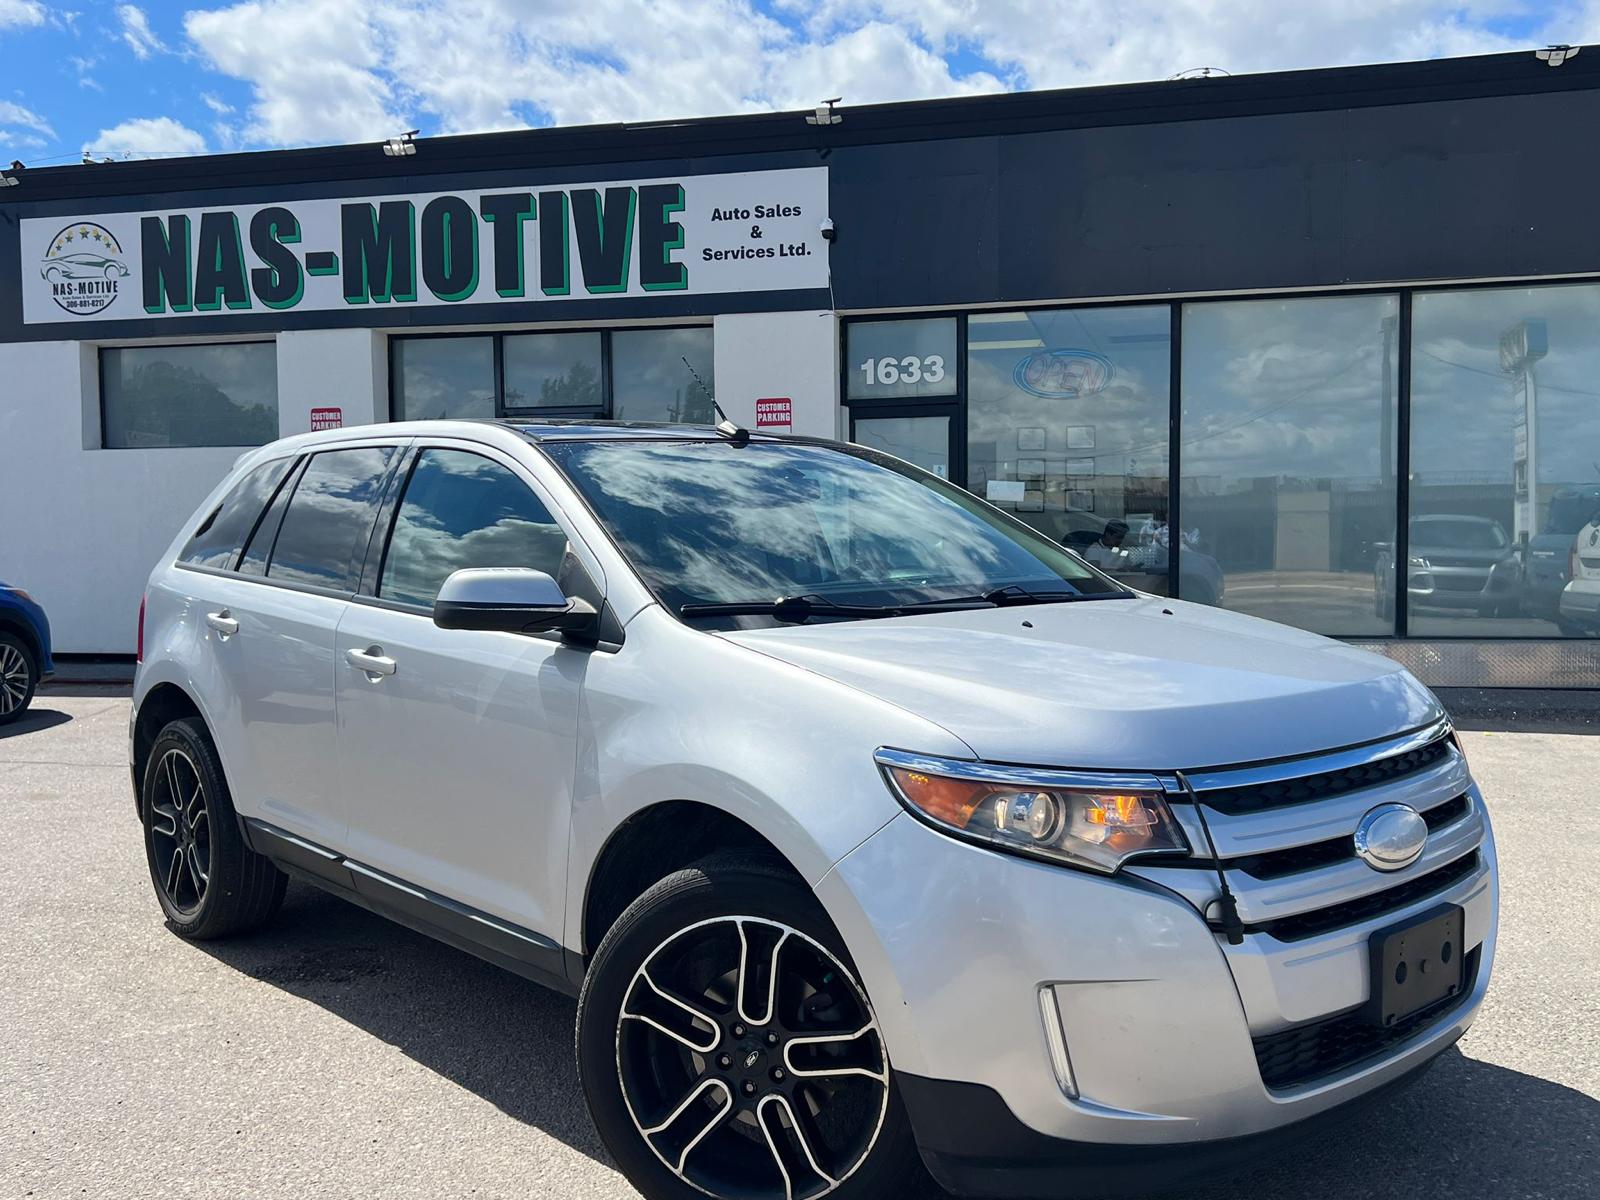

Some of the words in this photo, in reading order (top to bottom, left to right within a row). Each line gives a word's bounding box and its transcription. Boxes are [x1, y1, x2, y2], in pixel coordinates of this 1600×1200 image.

[711, 207, 750, 221] Auto
[754, 204, 802, 219] Sales
[750, 225, 763, 239] &
[141, 184, 688, 314] NAS-MOTIVE
[702, 245, 775, 261] Services
[779, 242, 811, 257] Ltd.
[53, 280, 118, 296] NAS-MOTIVE
[861, 355, 945, 385] 1633
[757, 403, 790, 412] CUSTOMER
[757, 413, 790, 422] PARKING
